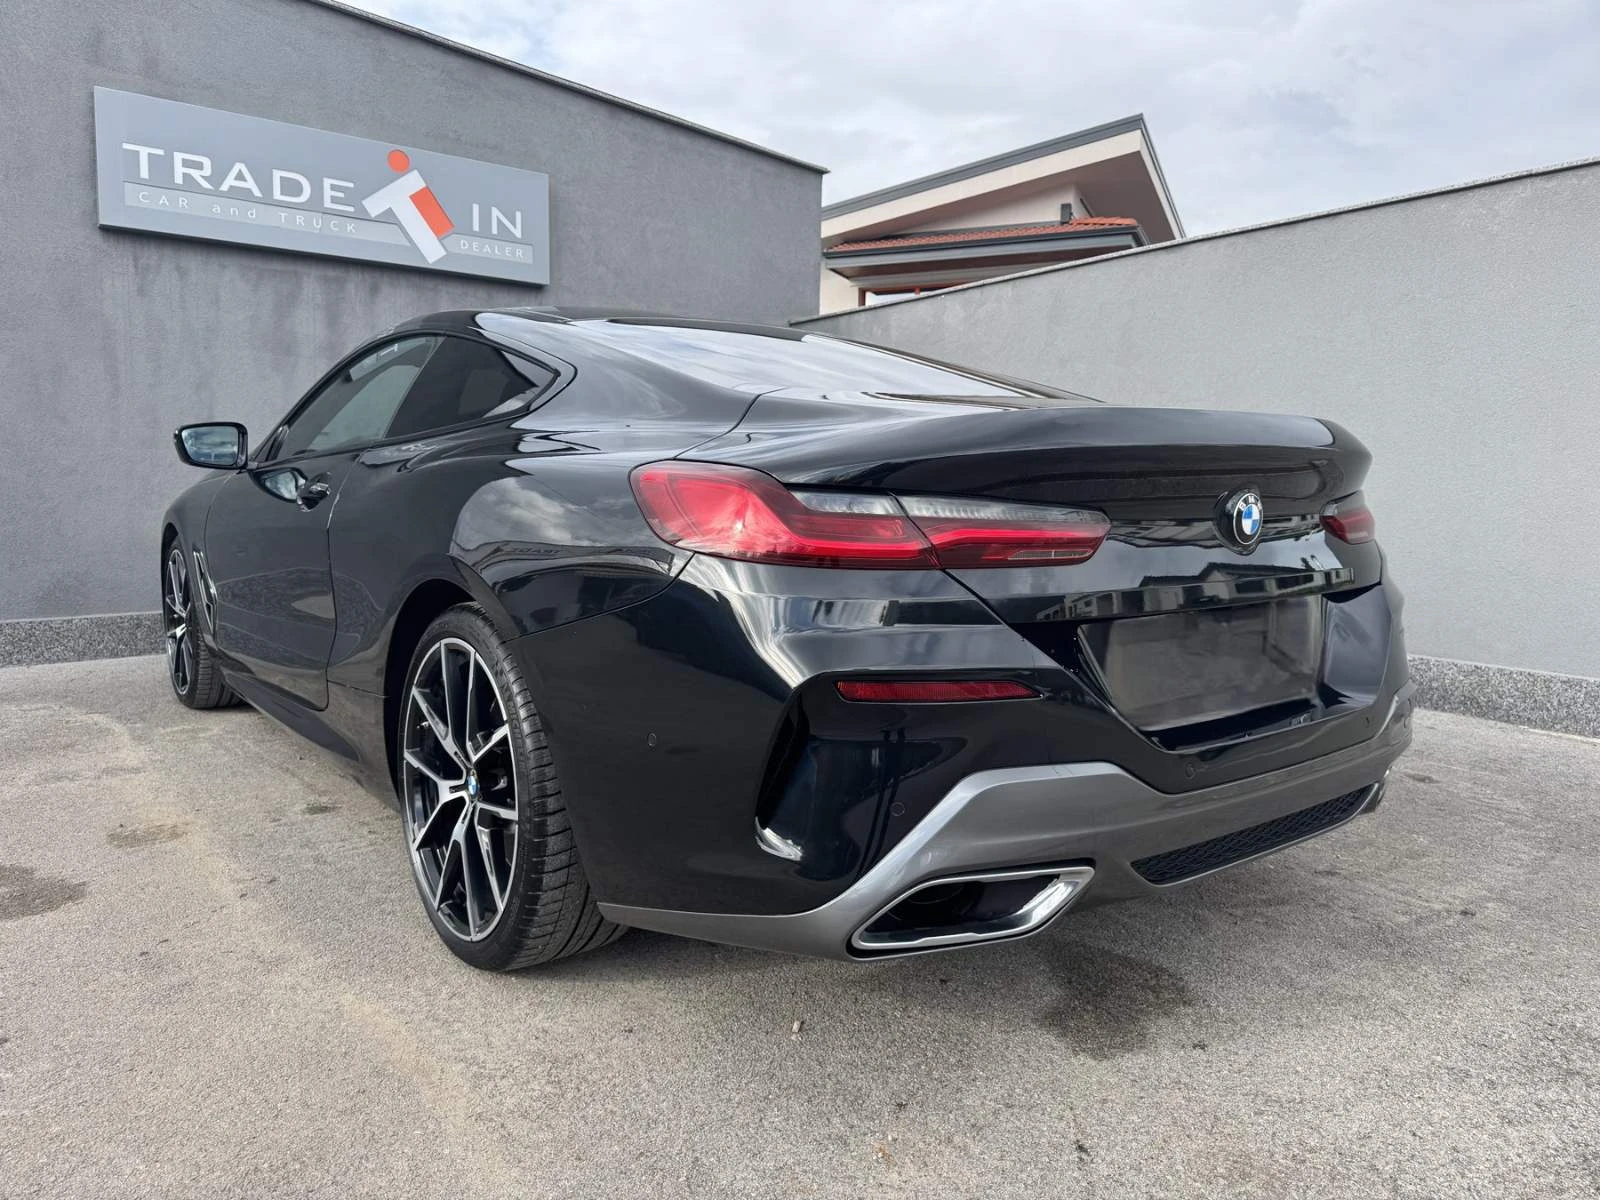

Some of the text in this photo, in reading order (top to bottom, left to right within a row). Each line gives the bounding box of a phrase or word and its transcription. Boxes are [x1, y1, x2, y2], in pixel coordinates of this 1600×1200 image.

[122, 142, 522, 239] TRADE IN
[139, 191, 357, 233] CAR and TRUCK
[460, 239, 524, 258] DEALER
